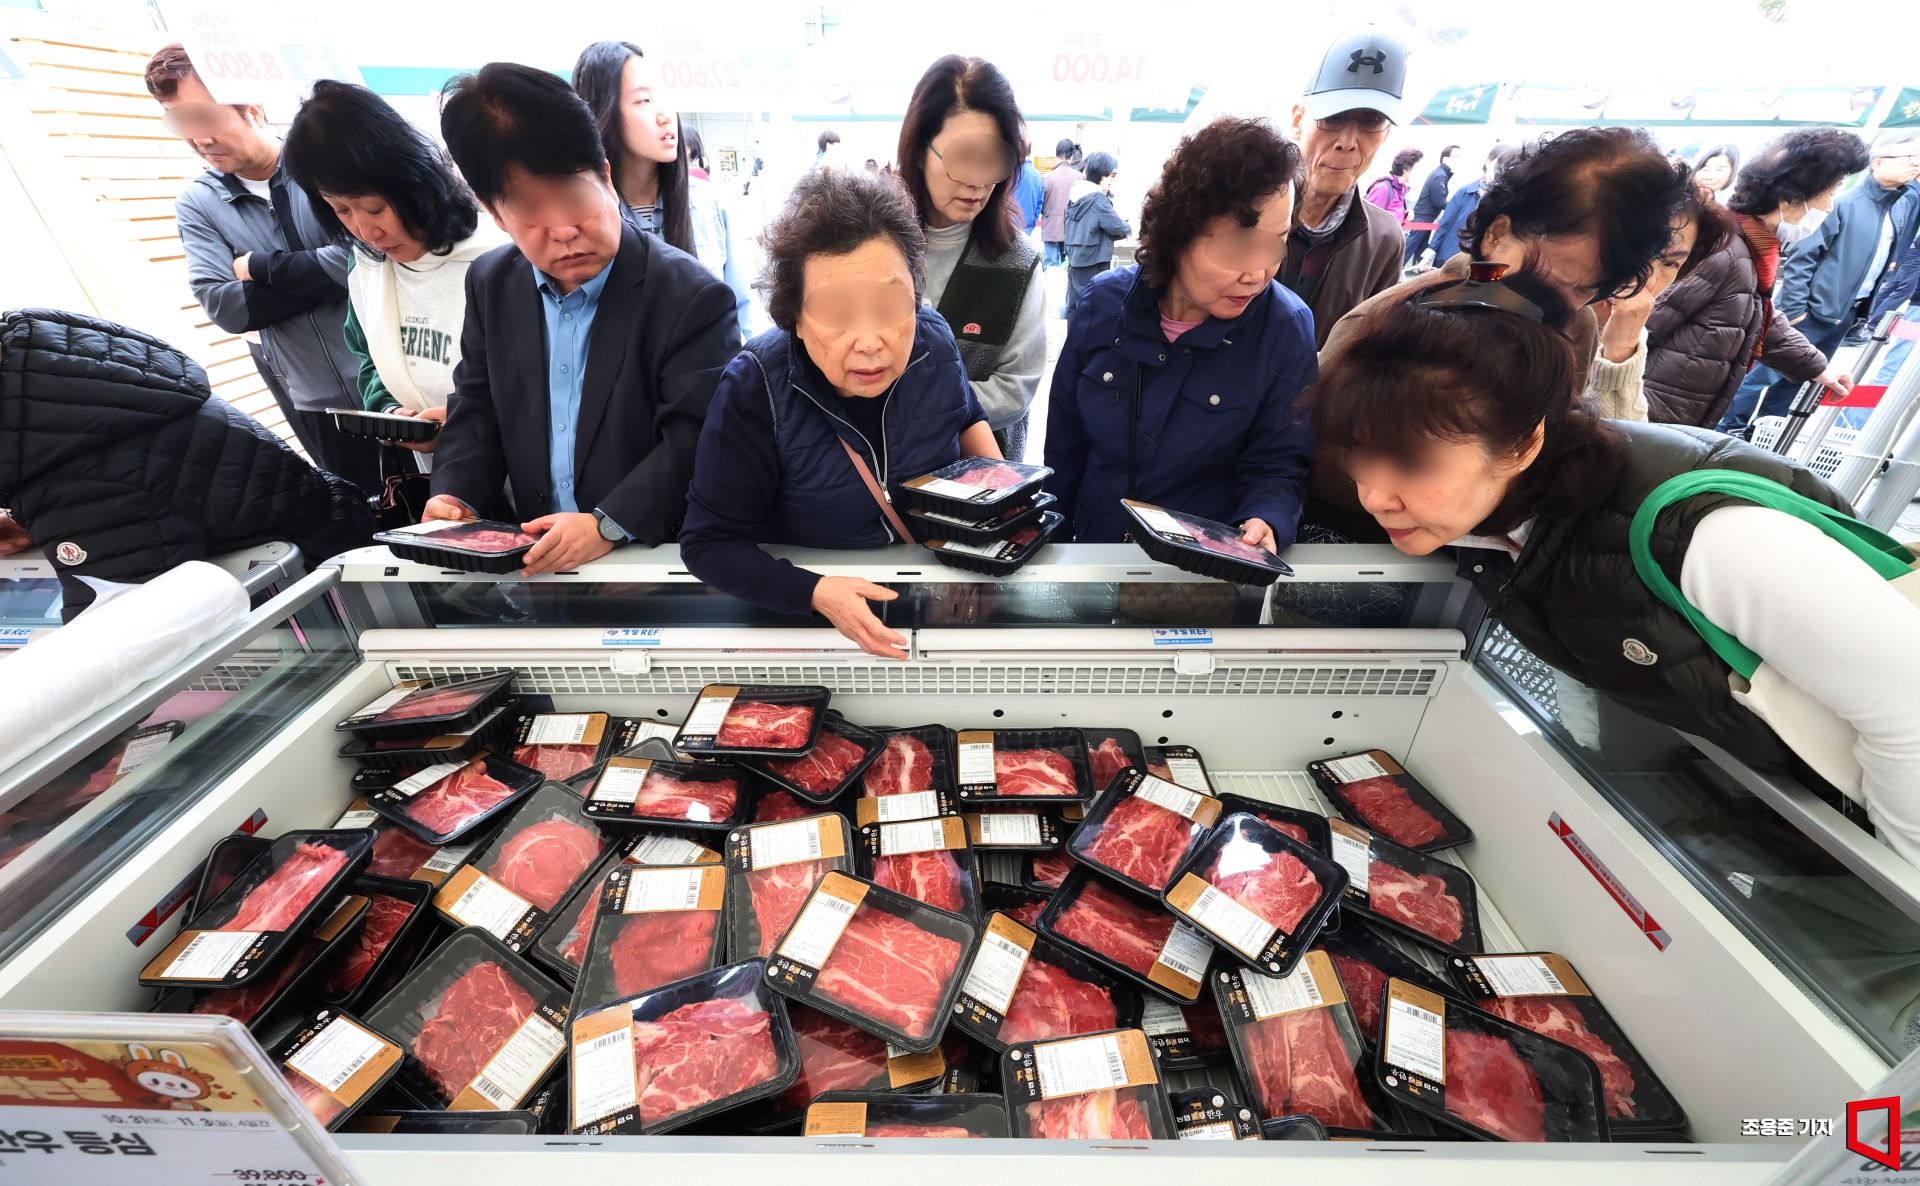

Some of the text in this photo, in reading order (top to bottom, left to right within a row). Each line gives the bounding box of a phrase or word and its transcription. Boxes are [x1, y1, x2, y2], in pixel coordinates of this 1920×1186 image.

[1205, 1108, 1223, 1119] 한우
[62, 1131, 158, 1156] 등심
[233, 1169, 307, 1181] 39,800
